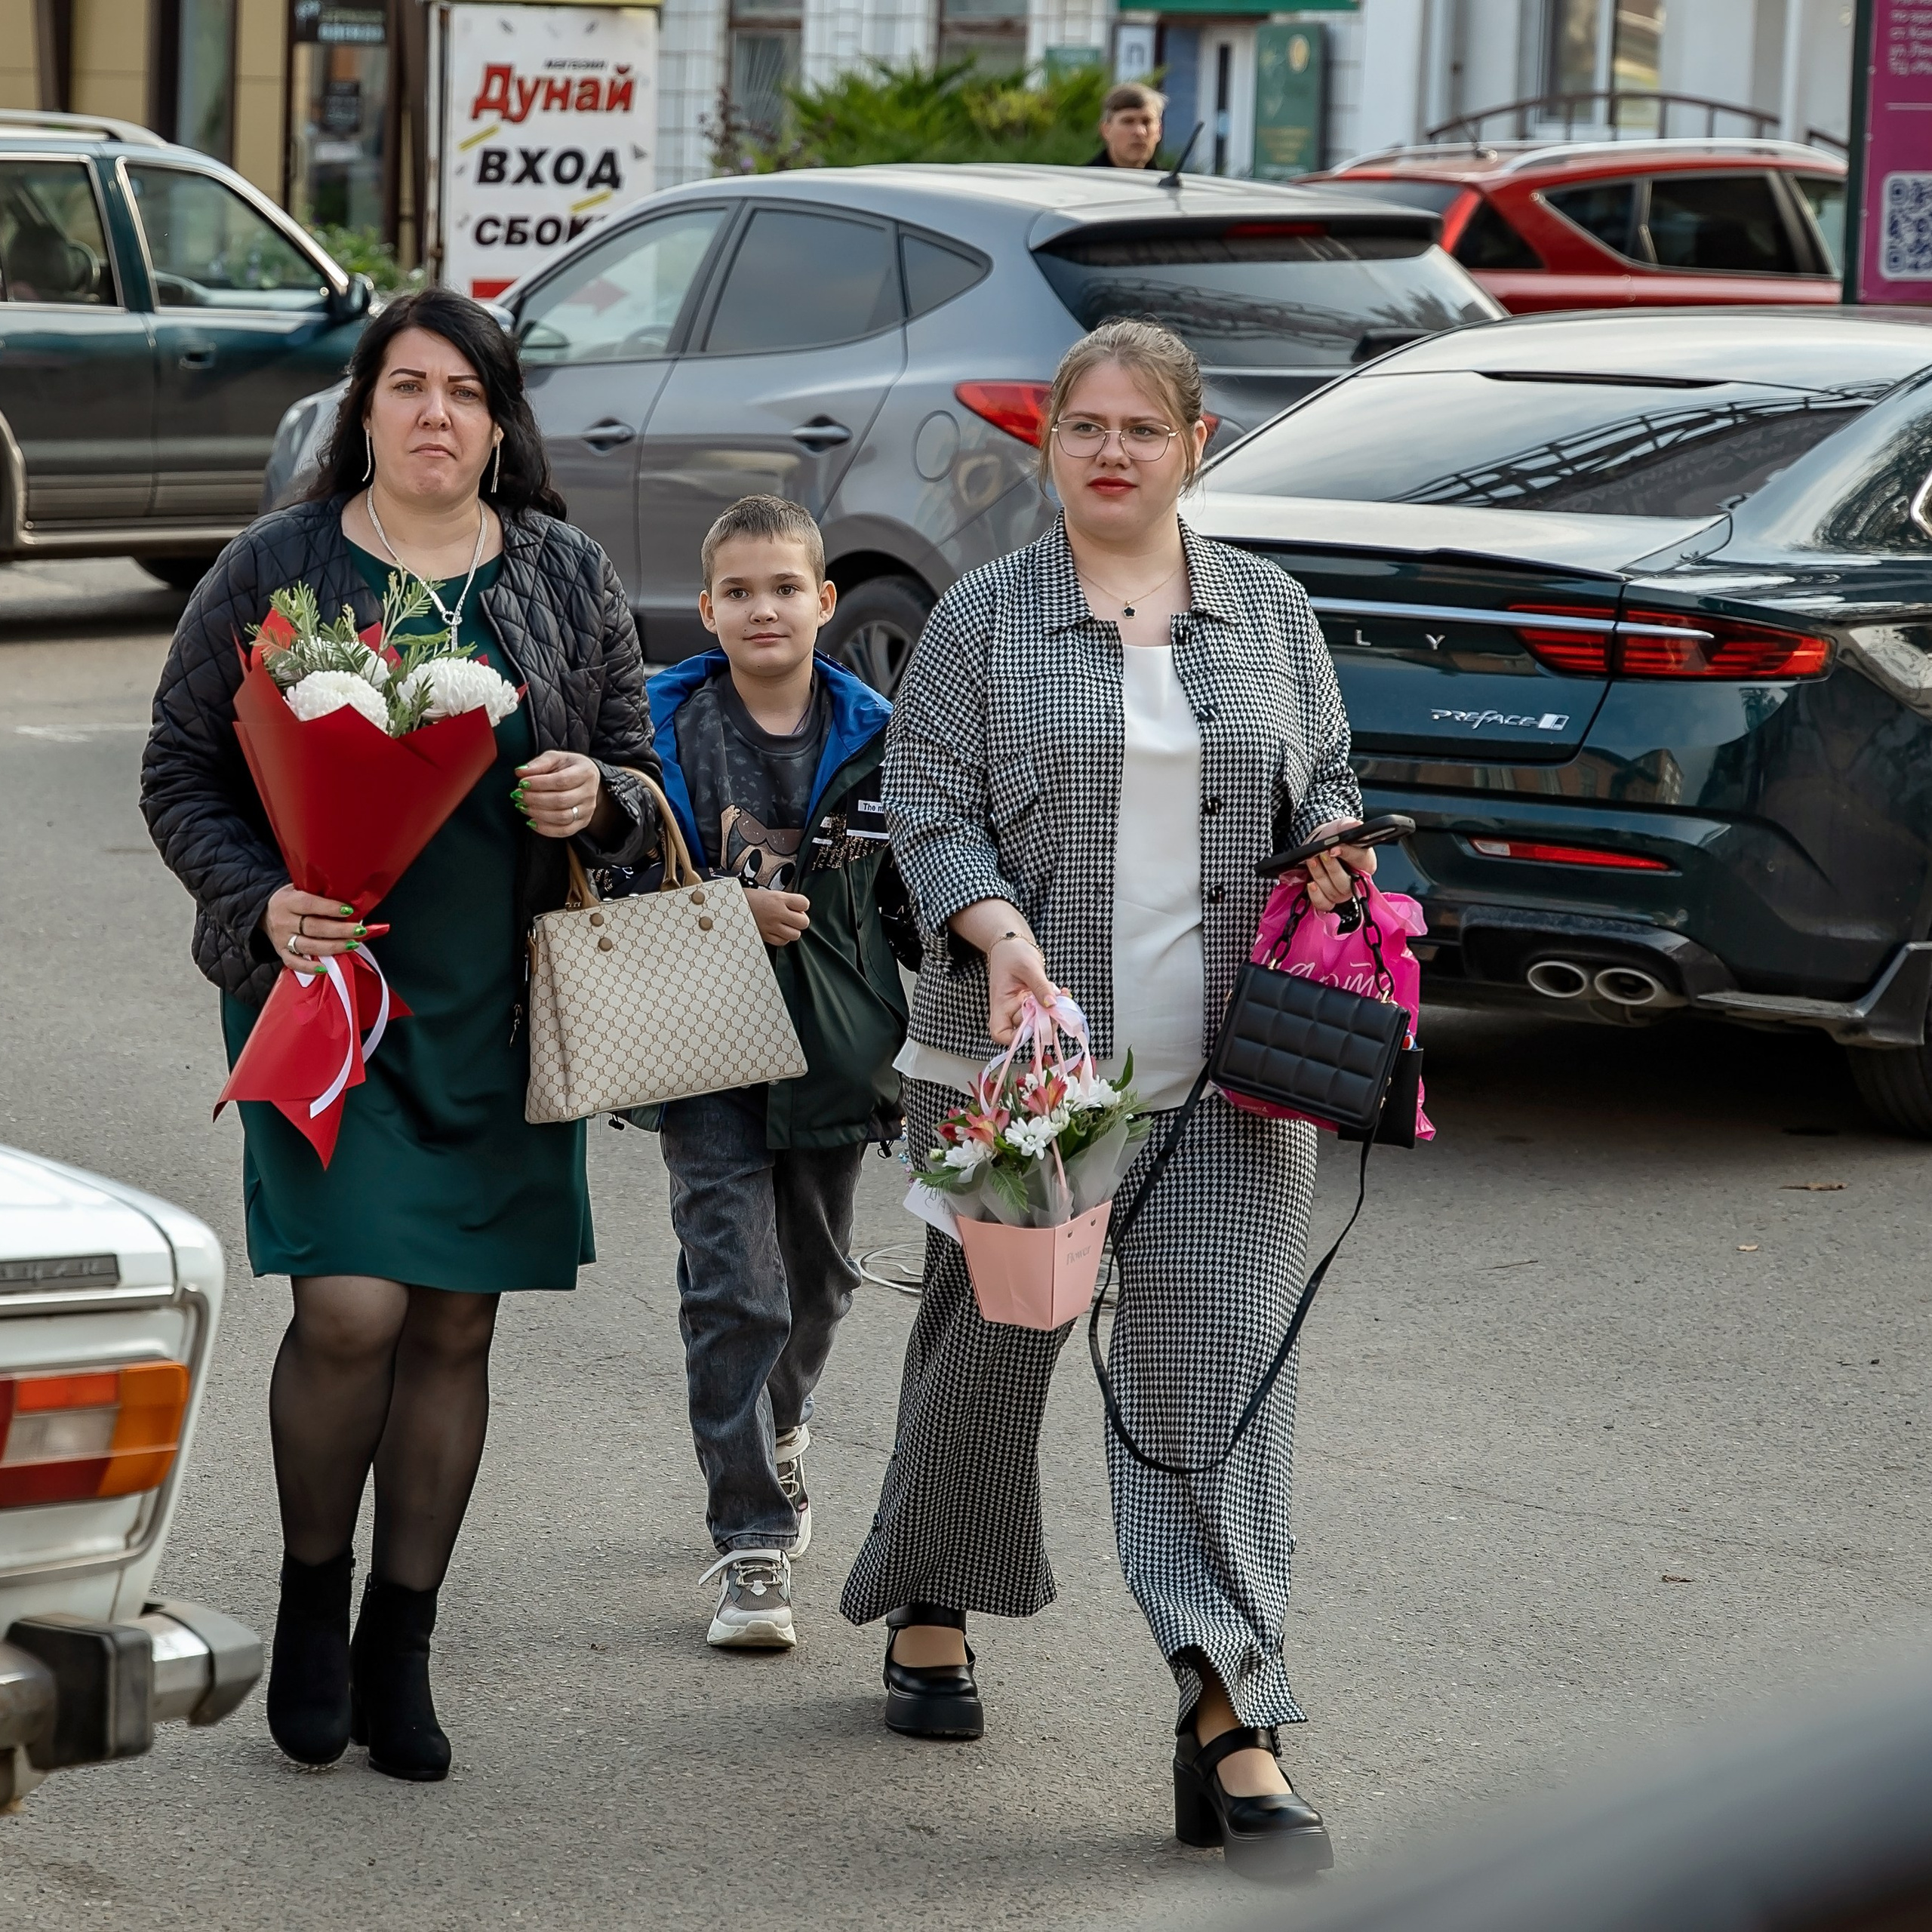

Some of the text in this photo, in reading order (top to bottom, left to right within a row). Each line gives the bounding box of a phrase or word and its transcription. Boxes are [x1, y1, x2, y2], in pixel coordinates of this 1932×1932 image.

[470, 63, 634, 123] Дунай
[476, 149, 622, 189] ВХОД
[475, 214, 608, 247] СБОК
